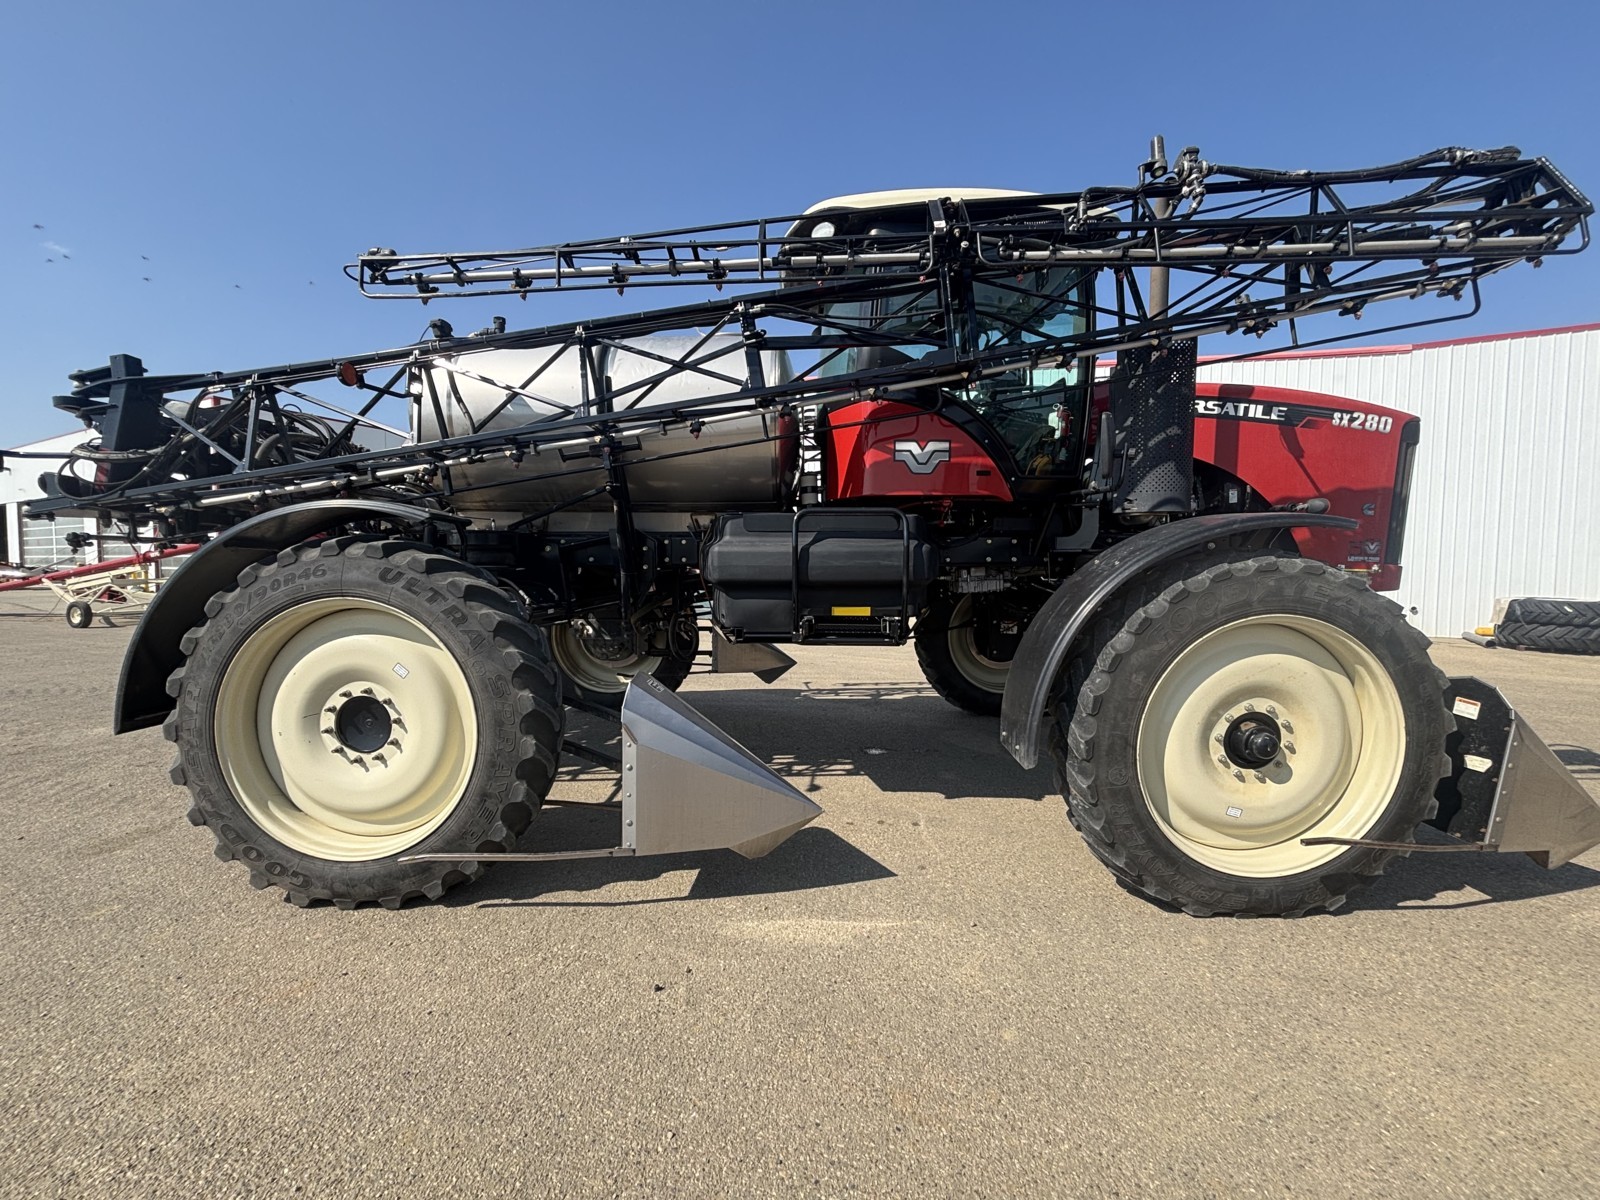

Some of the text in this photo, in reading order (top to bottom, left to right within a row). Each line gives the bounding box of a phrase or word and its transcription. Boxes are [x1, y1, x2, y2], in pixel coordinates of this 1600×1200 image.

[1194, 400, 1288, 420] RSATILE
[1332, 411, 1393, 434] SX280
[378, 567, 486, 651] ULTRA
[462, 674, 516, 844] SPRAYER
